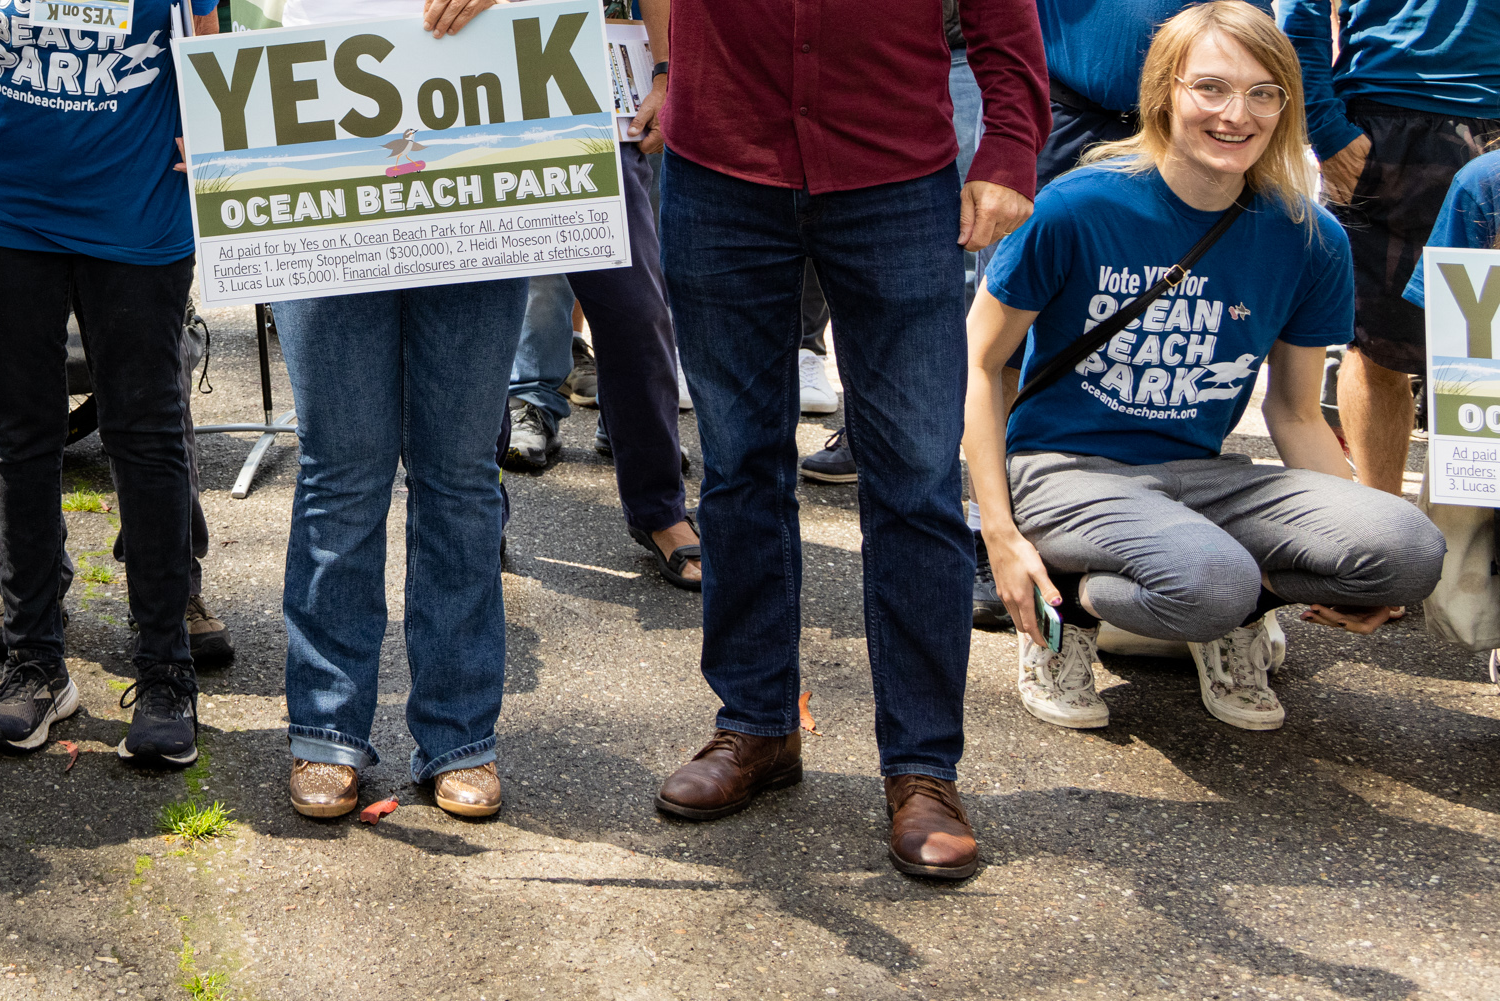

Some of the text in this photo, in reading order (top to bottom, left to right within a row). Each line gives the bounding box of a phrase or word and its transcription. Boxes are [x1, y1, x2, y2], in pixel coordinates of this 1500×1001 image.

[46, 3, 115, 26] YES on K
[187, 34, 403, 151] YES
[417, 73, 505, 131] on
[512, 12, 602, 121] K
[220, 163, 598, 229] OCEAN BEACH PARK
[217, 244, 615, 293] 3. Lucas Lux ($5,000). Financial disclosures are available at sfethics.org.
[1098, 265, 1141, 294] Vote
[1075, 352, 1208, 406] PARK
[1081, 381, 1198, 420] oceanbeachpark.org
[1446, 462, 1497, 478] Funders:
[1453, 446, 1497, 462] Ad paid
[1449, 478, 1496, 493] 3. Lucas
